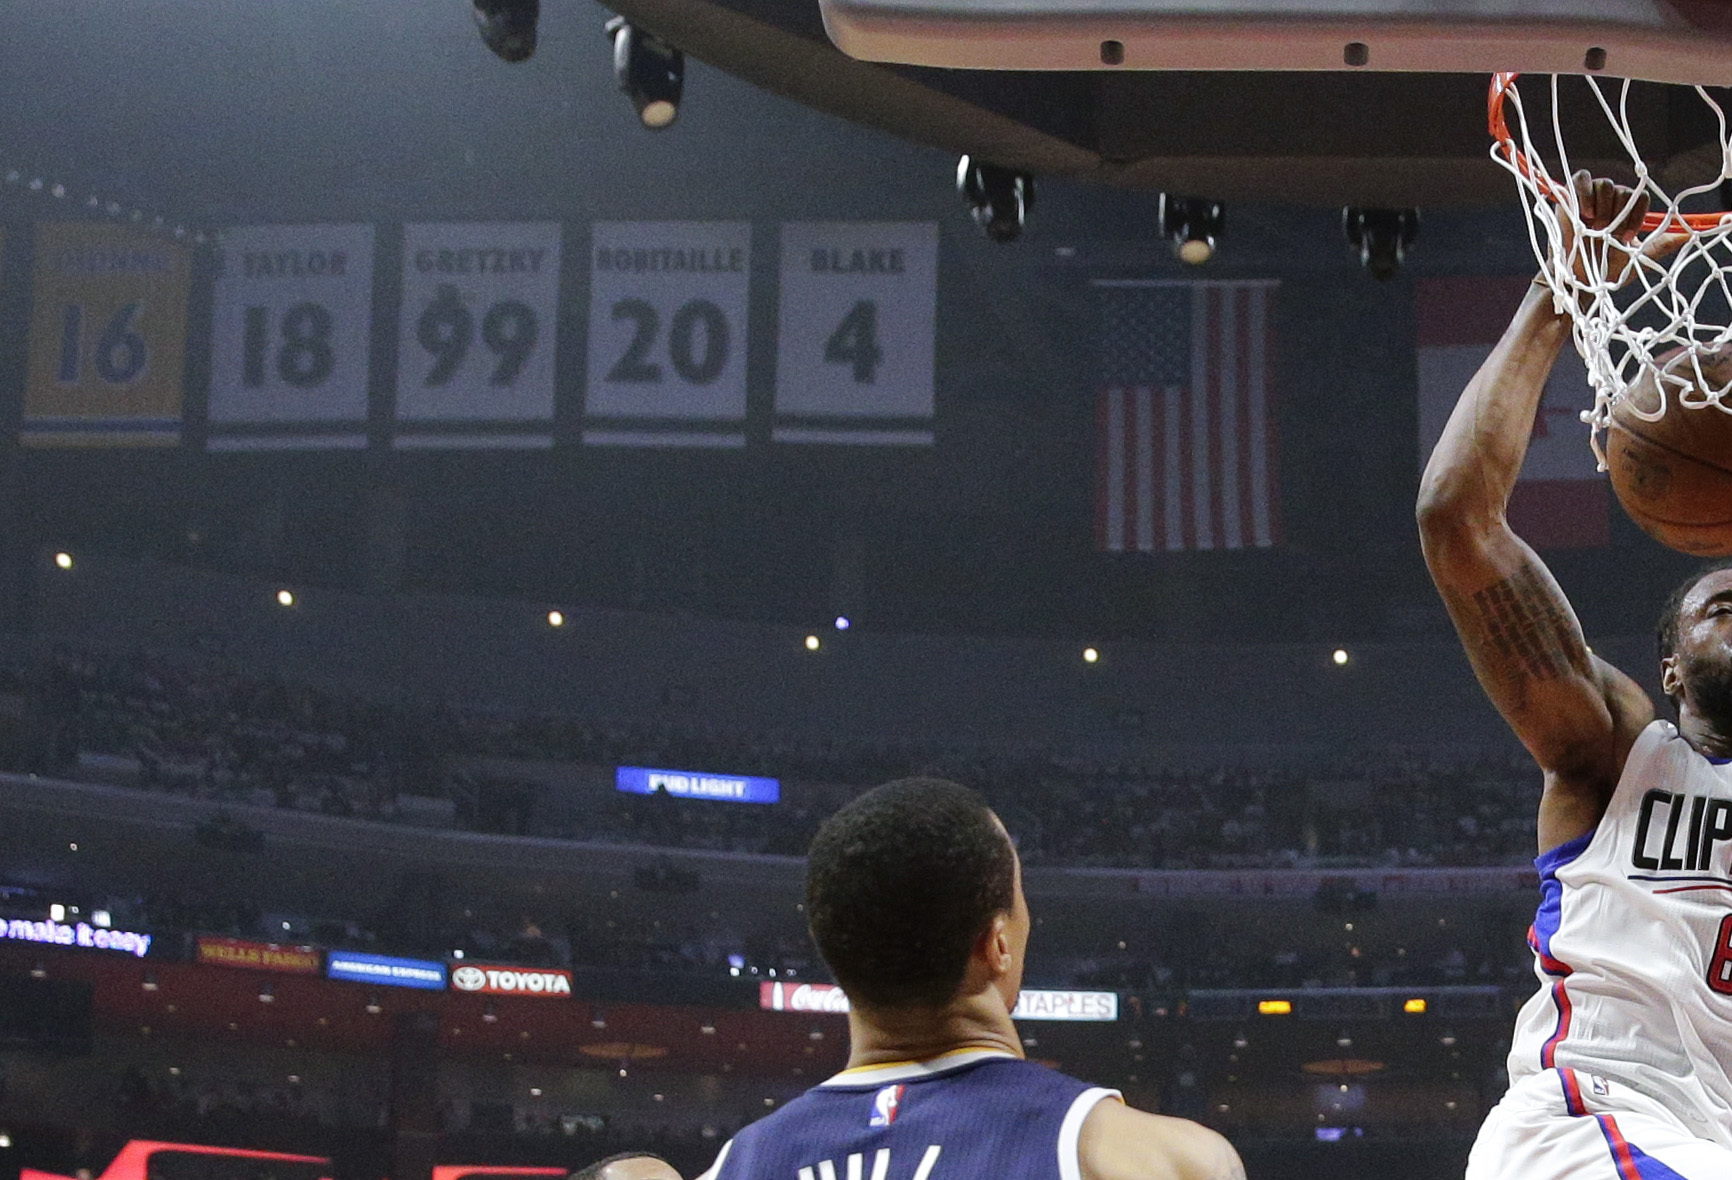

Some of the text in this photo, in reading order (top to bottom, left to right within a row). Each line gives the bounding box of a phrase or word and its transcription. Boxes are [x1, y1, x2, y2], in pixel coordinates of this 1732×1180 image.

[242, 250, 347, 278] TAYLOR
[57, 301, 148, 384] 16
[242, 302, 335, 388] 18
[415, 298, 538, 388] 99
[603, 298, 732, 386] 20
[822, 299, 885, 386] 4
[690, 777, 746, 797] LIGHT
[486, 970, 571, 994] TOYOTA
[1014, 992, 1112, 1016] TAPLES
